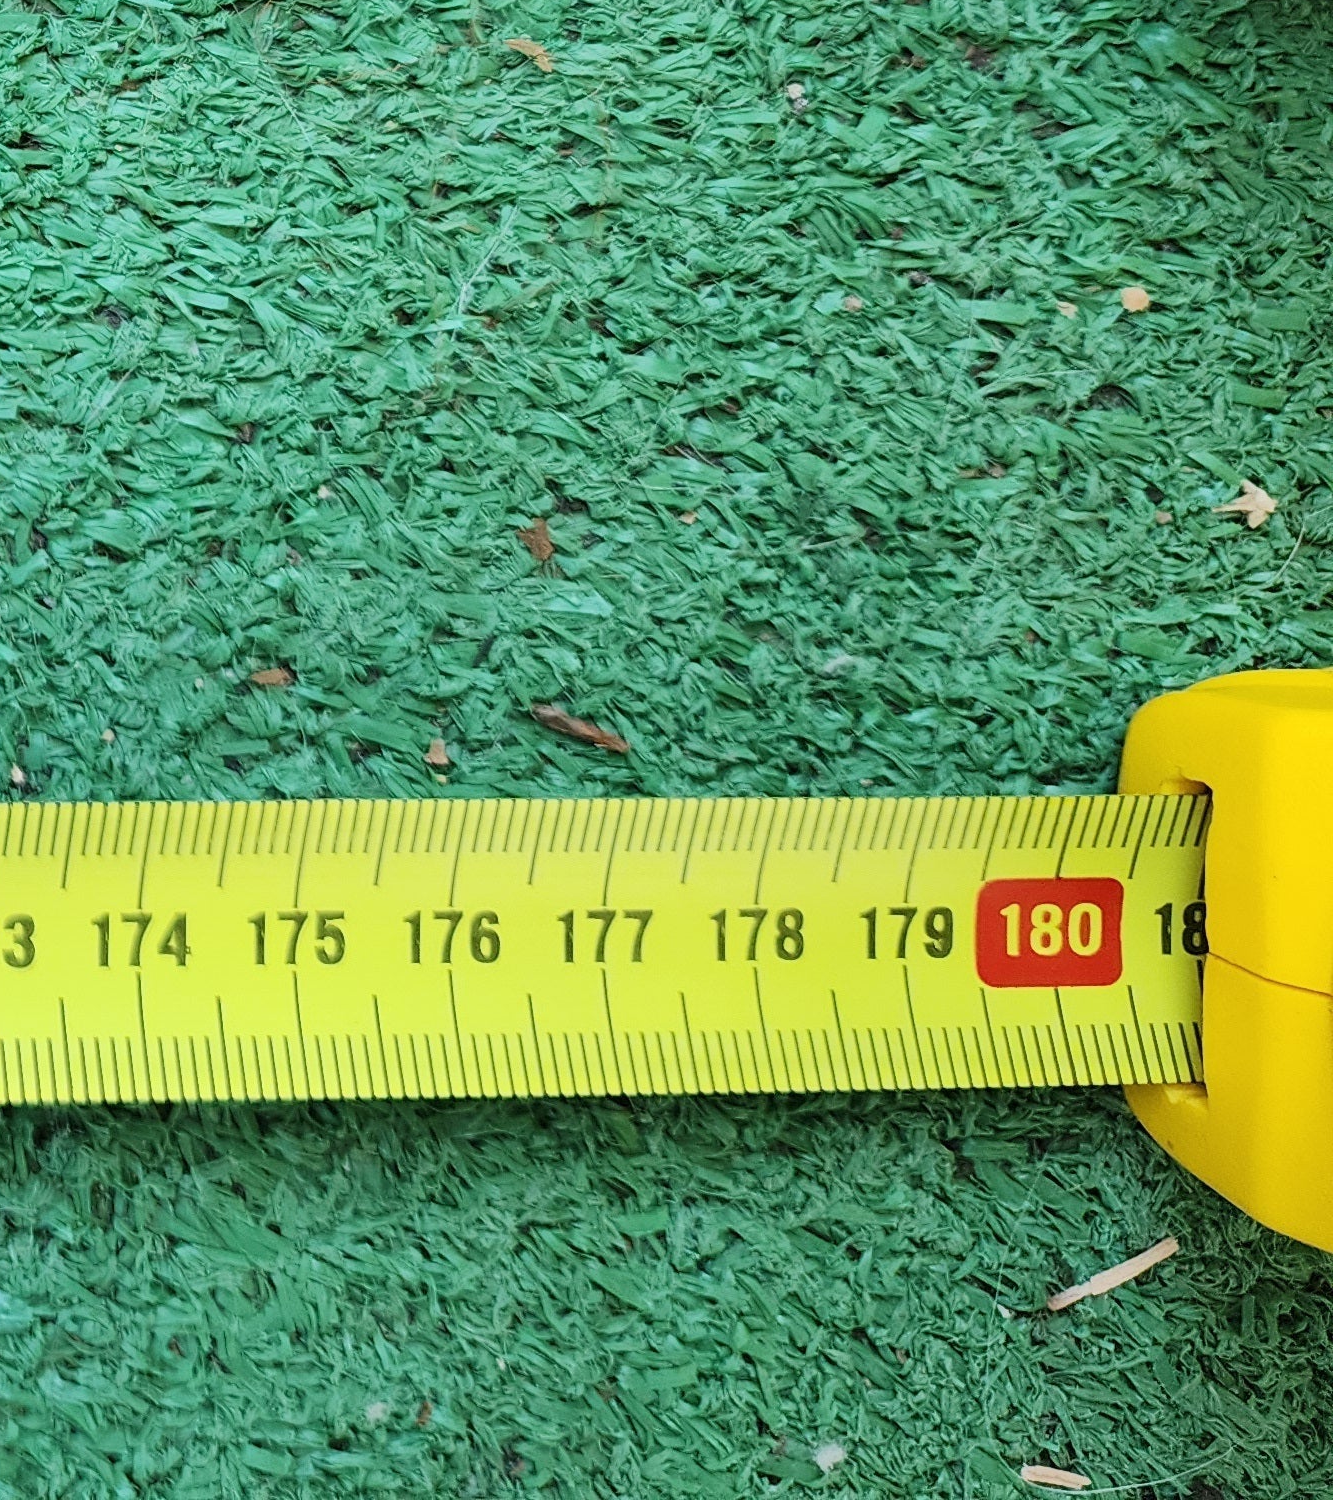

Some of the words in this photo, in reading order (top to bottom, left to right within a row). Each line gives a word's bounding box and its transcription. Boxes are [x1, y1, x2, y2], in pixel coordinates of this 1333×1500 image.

[92, 912, 192, 967] 174
[248, 911, 346, 965] 175
[404, 911, 501, 964] 176
[558, 909, 654, 963] 177
[710, 908, 805, 961] 178
[860, 907, 954, 959] 179
[1000, 903, 1103, 956] 180
